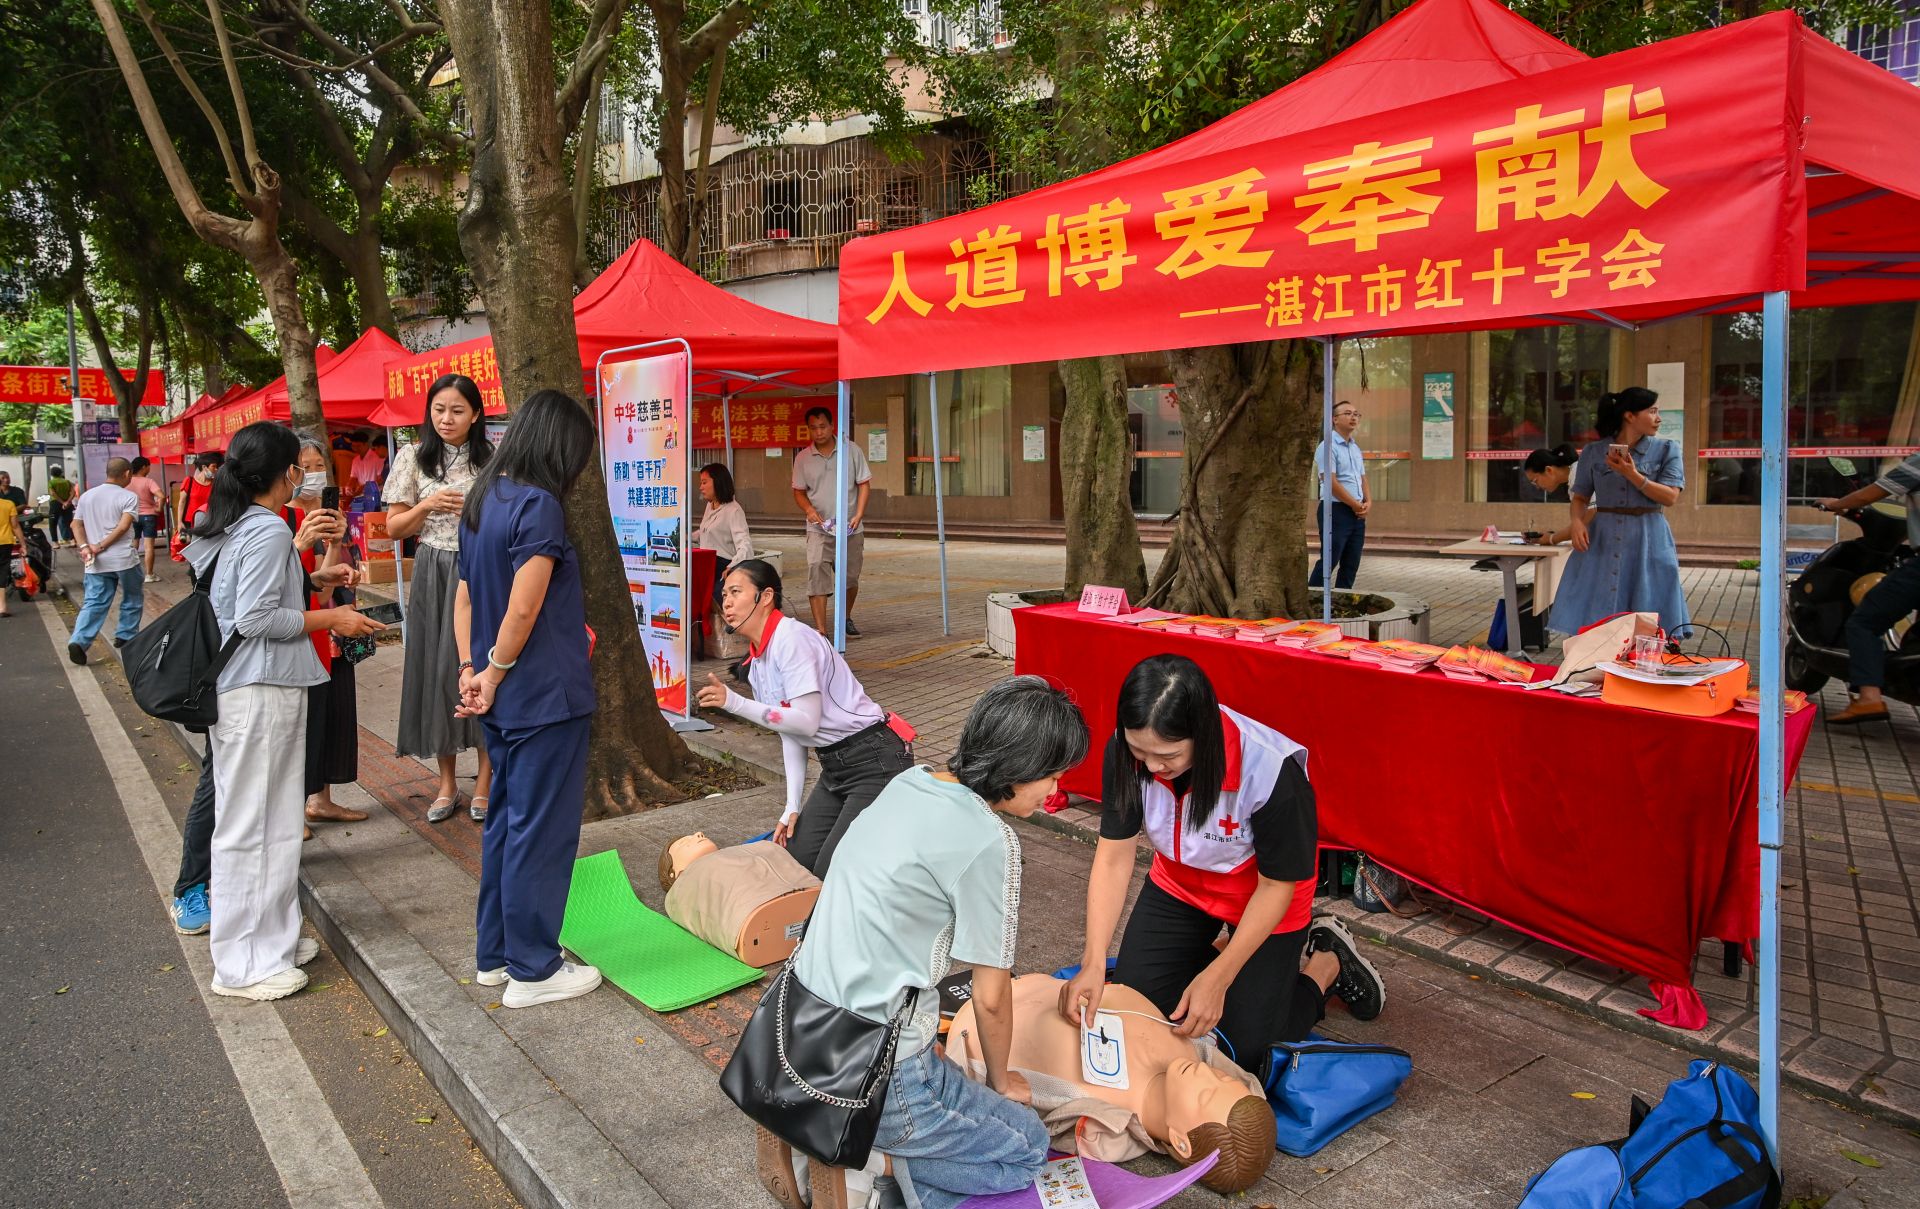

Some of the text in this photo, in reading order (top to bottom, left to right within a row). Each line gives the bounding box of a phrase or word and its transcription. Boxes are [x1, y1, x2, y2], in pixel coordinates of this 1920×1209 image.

[866, 83, 1670, 325] 人道博爱奉献
[614, 398, 673, 423] 中华慈善日
[627, 486, 678, 508] 共建美好湛江
[948, 985, 971, 1000] AED
